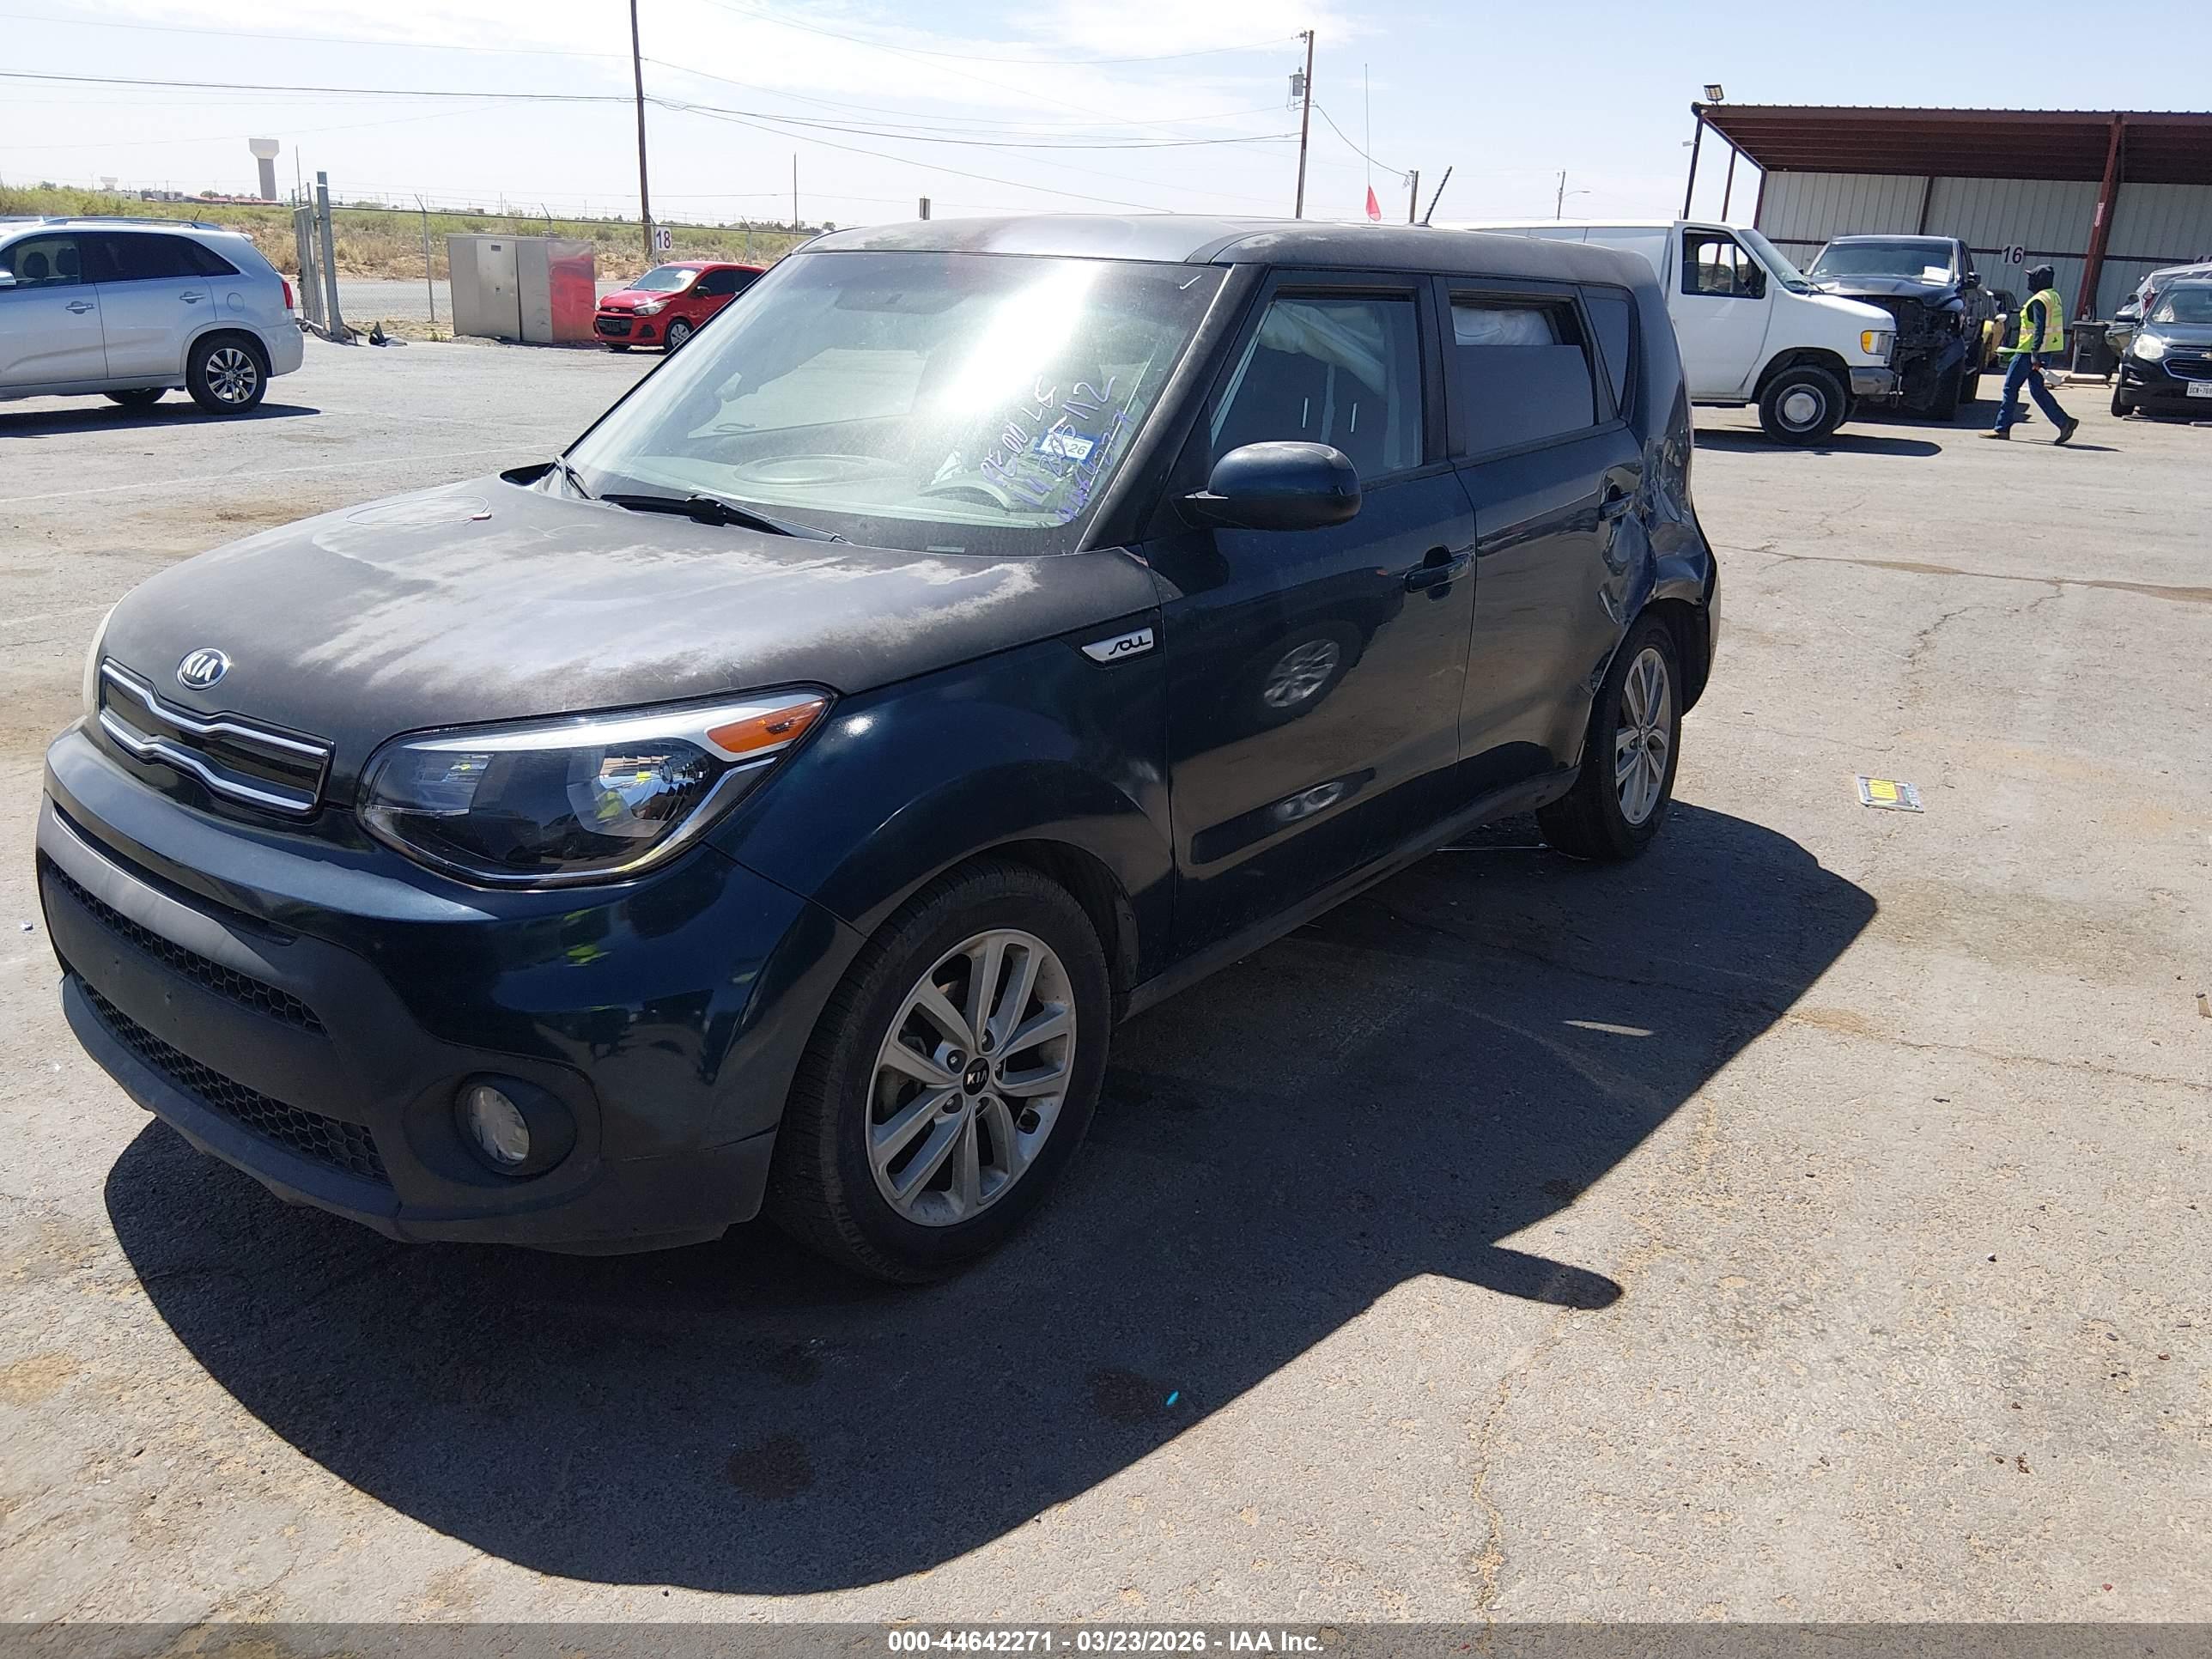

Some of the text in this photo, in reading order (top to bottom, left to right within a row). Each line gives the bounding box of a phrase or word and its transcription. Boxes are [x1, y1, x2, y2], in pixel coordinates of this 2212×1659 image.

[656, 229, 671, 249] 18
[2003, 245, 2023, 264] 16
[1067, 443, 1087, 456] 26
[1108, 635, 1152, 656] SOUL
[183, 653, 219, 682] KIA
[966, 1070, 988, 1085] KIA
